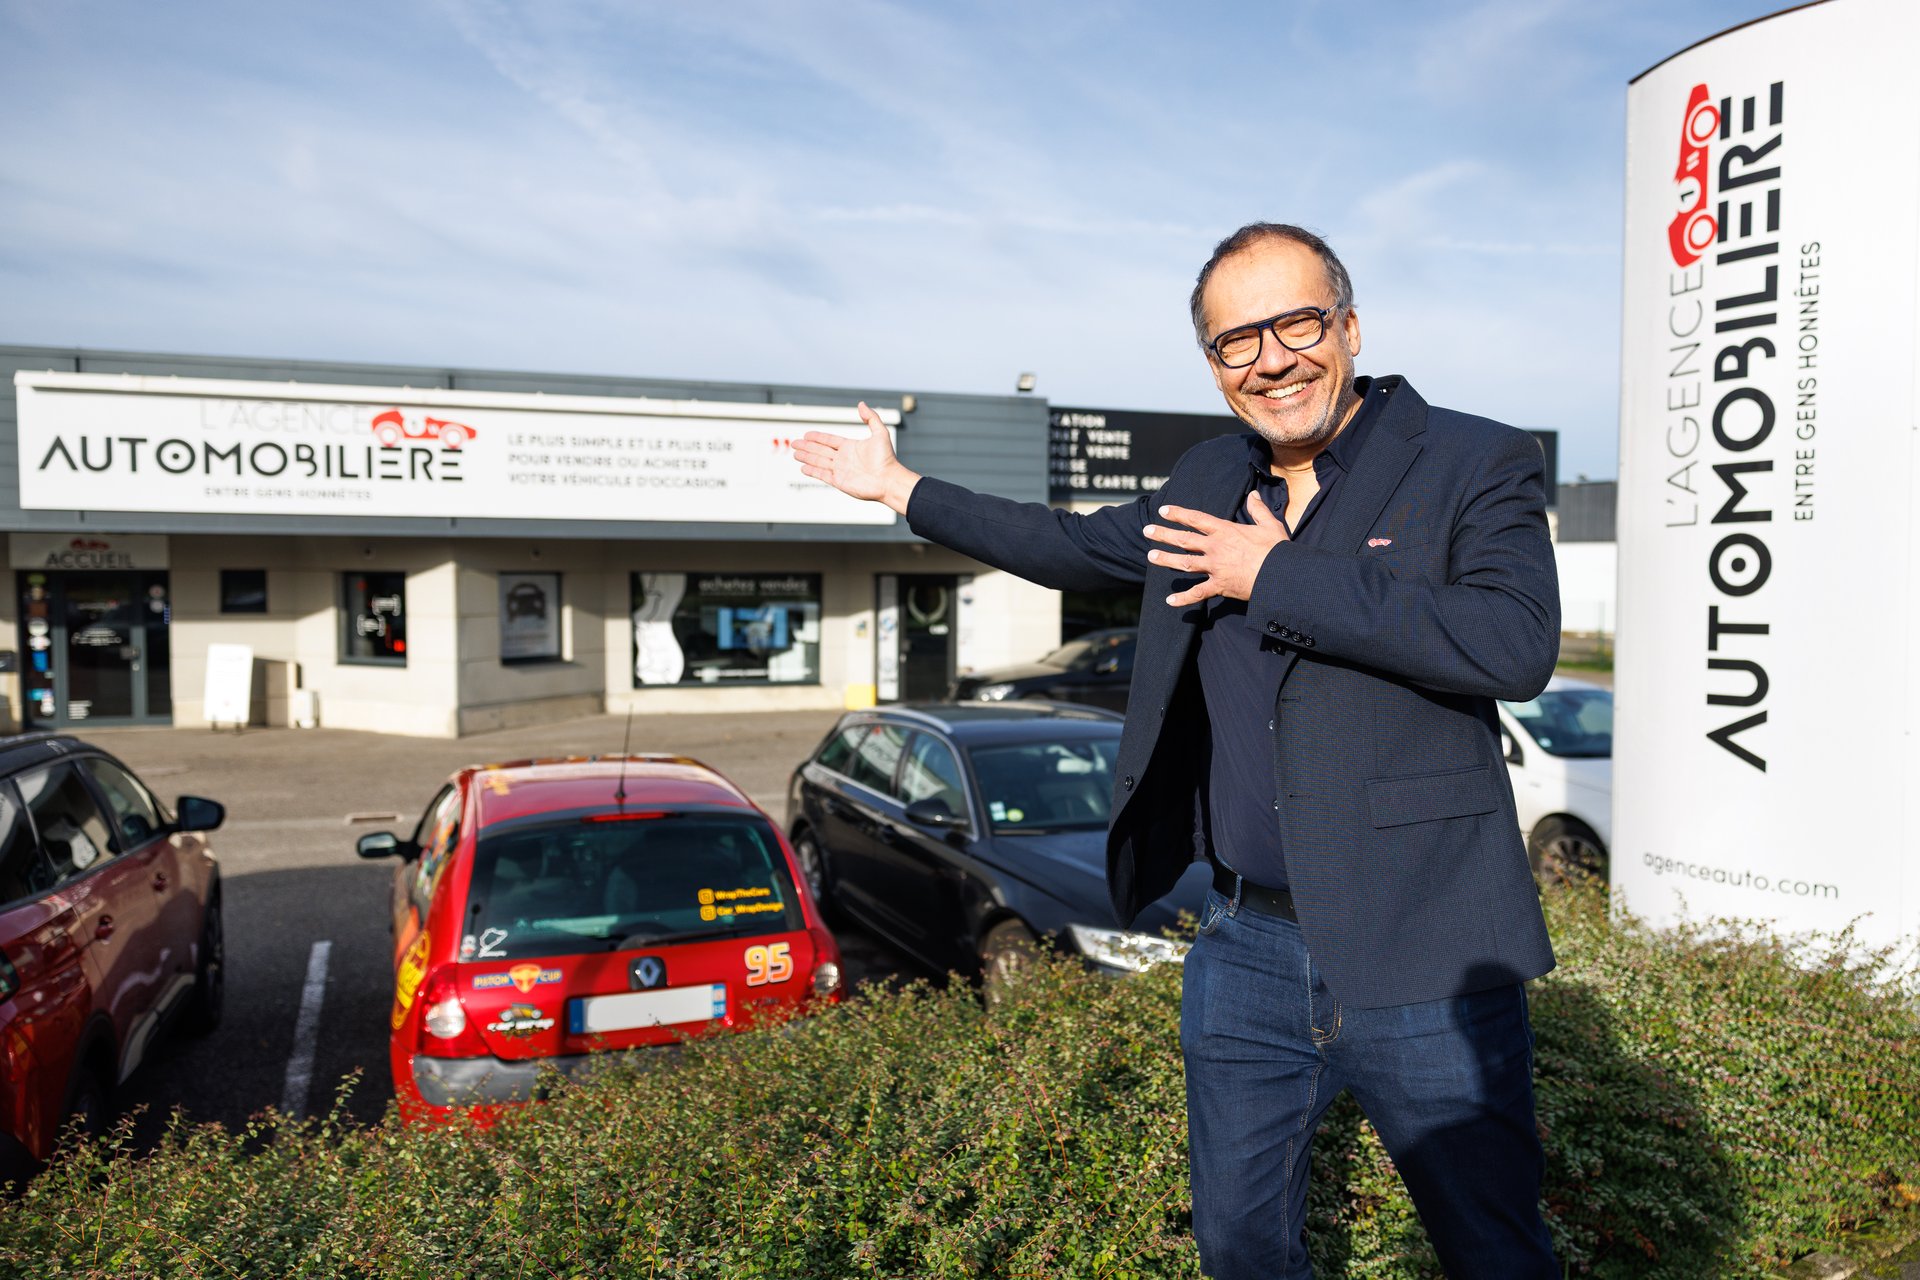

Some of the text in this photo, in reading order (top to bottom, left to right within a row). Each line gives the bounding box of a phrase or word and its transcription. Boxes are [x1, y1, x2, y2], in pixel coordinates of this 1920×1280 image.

[1793, 241, 1821, 522] ENTRE GENS HONNÊTES
[1665, 262, 1705, 528] L'AGENCE
[201, 400, 371, 436] L'AGENCE
[507, 433, 524, 446] LE
[528, 434, 565, 447] PLUS
[571, 435, 624, 449] SIMPLE
[628, 438, 645, 450] ET
[648, 439, 663, 451] LE
[668, 440, 702, 452] PLUS
[1086, 430, 1131, 445] VENTE
[1085, 444, 1130, 460] VENTE
[508, 453, 709, 471] POUR VENDRE OU ACHETER
[508, 471, 557, 484] VOTRE
[637, 475, 728, 490] D'OCCASION
[1092, 474, 1138, 490] CARTE
[204, 486, 249, 498] ENTRE
[254, 487, 294, 499] GENS
[45, 551, 134, 569] ACCUEIL
[1642, 852, 1840, 899] agenceauto.com
[744, 941, 794, 987] 95
[541, 970, 562, 983] CUP
